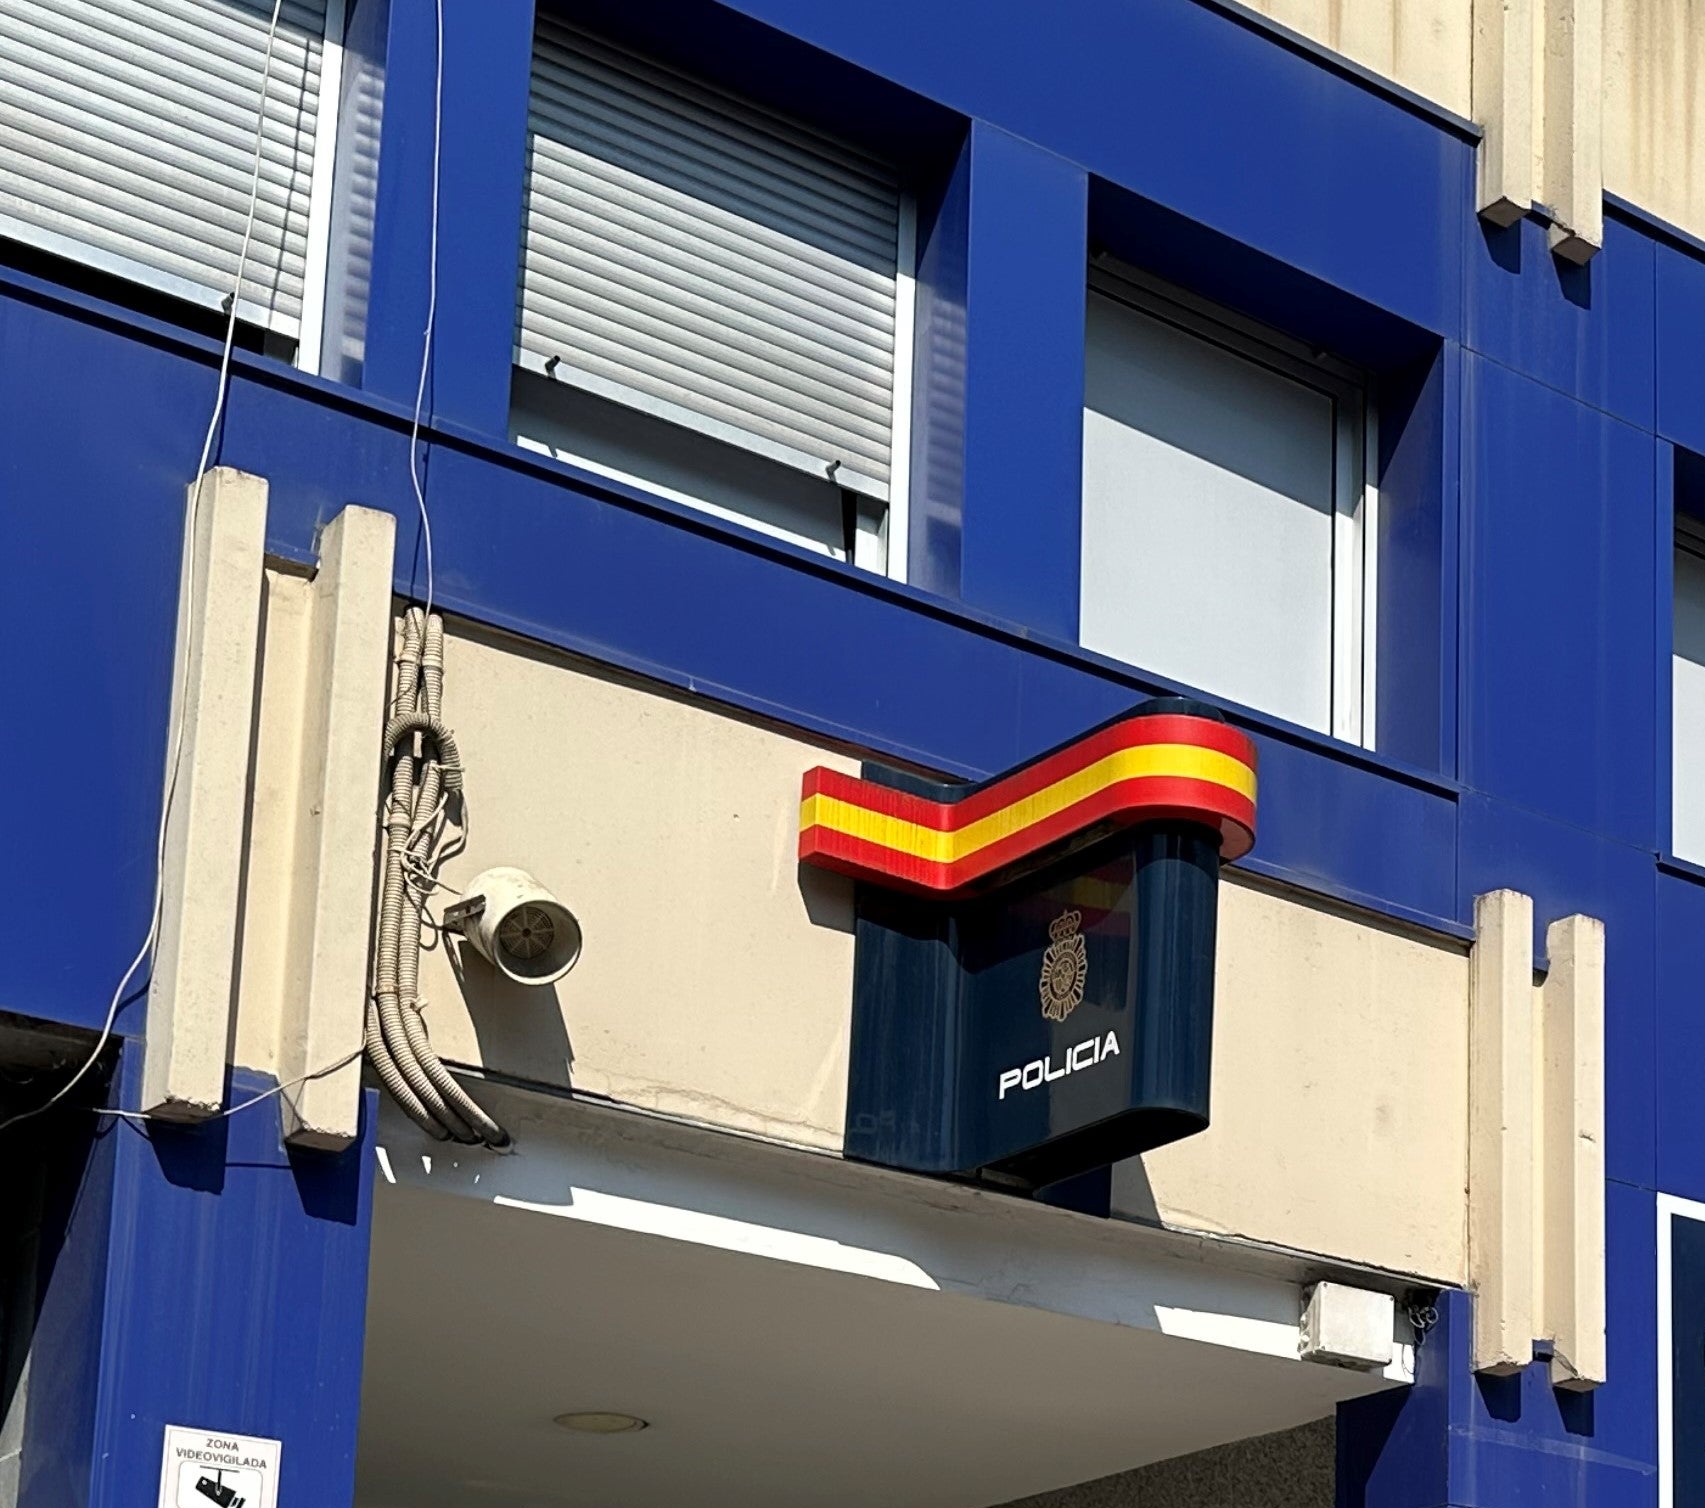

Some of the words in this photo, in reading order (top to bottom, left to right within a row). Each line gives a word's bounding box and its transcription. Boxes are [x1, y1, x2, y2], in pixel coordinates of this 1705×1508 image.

[999, 1030, 1120, 1100] POLICIA
[206, 1438, 239, 1451] ZONA
[176, 1447, 267, 1469] VIDEOVIGILADA
